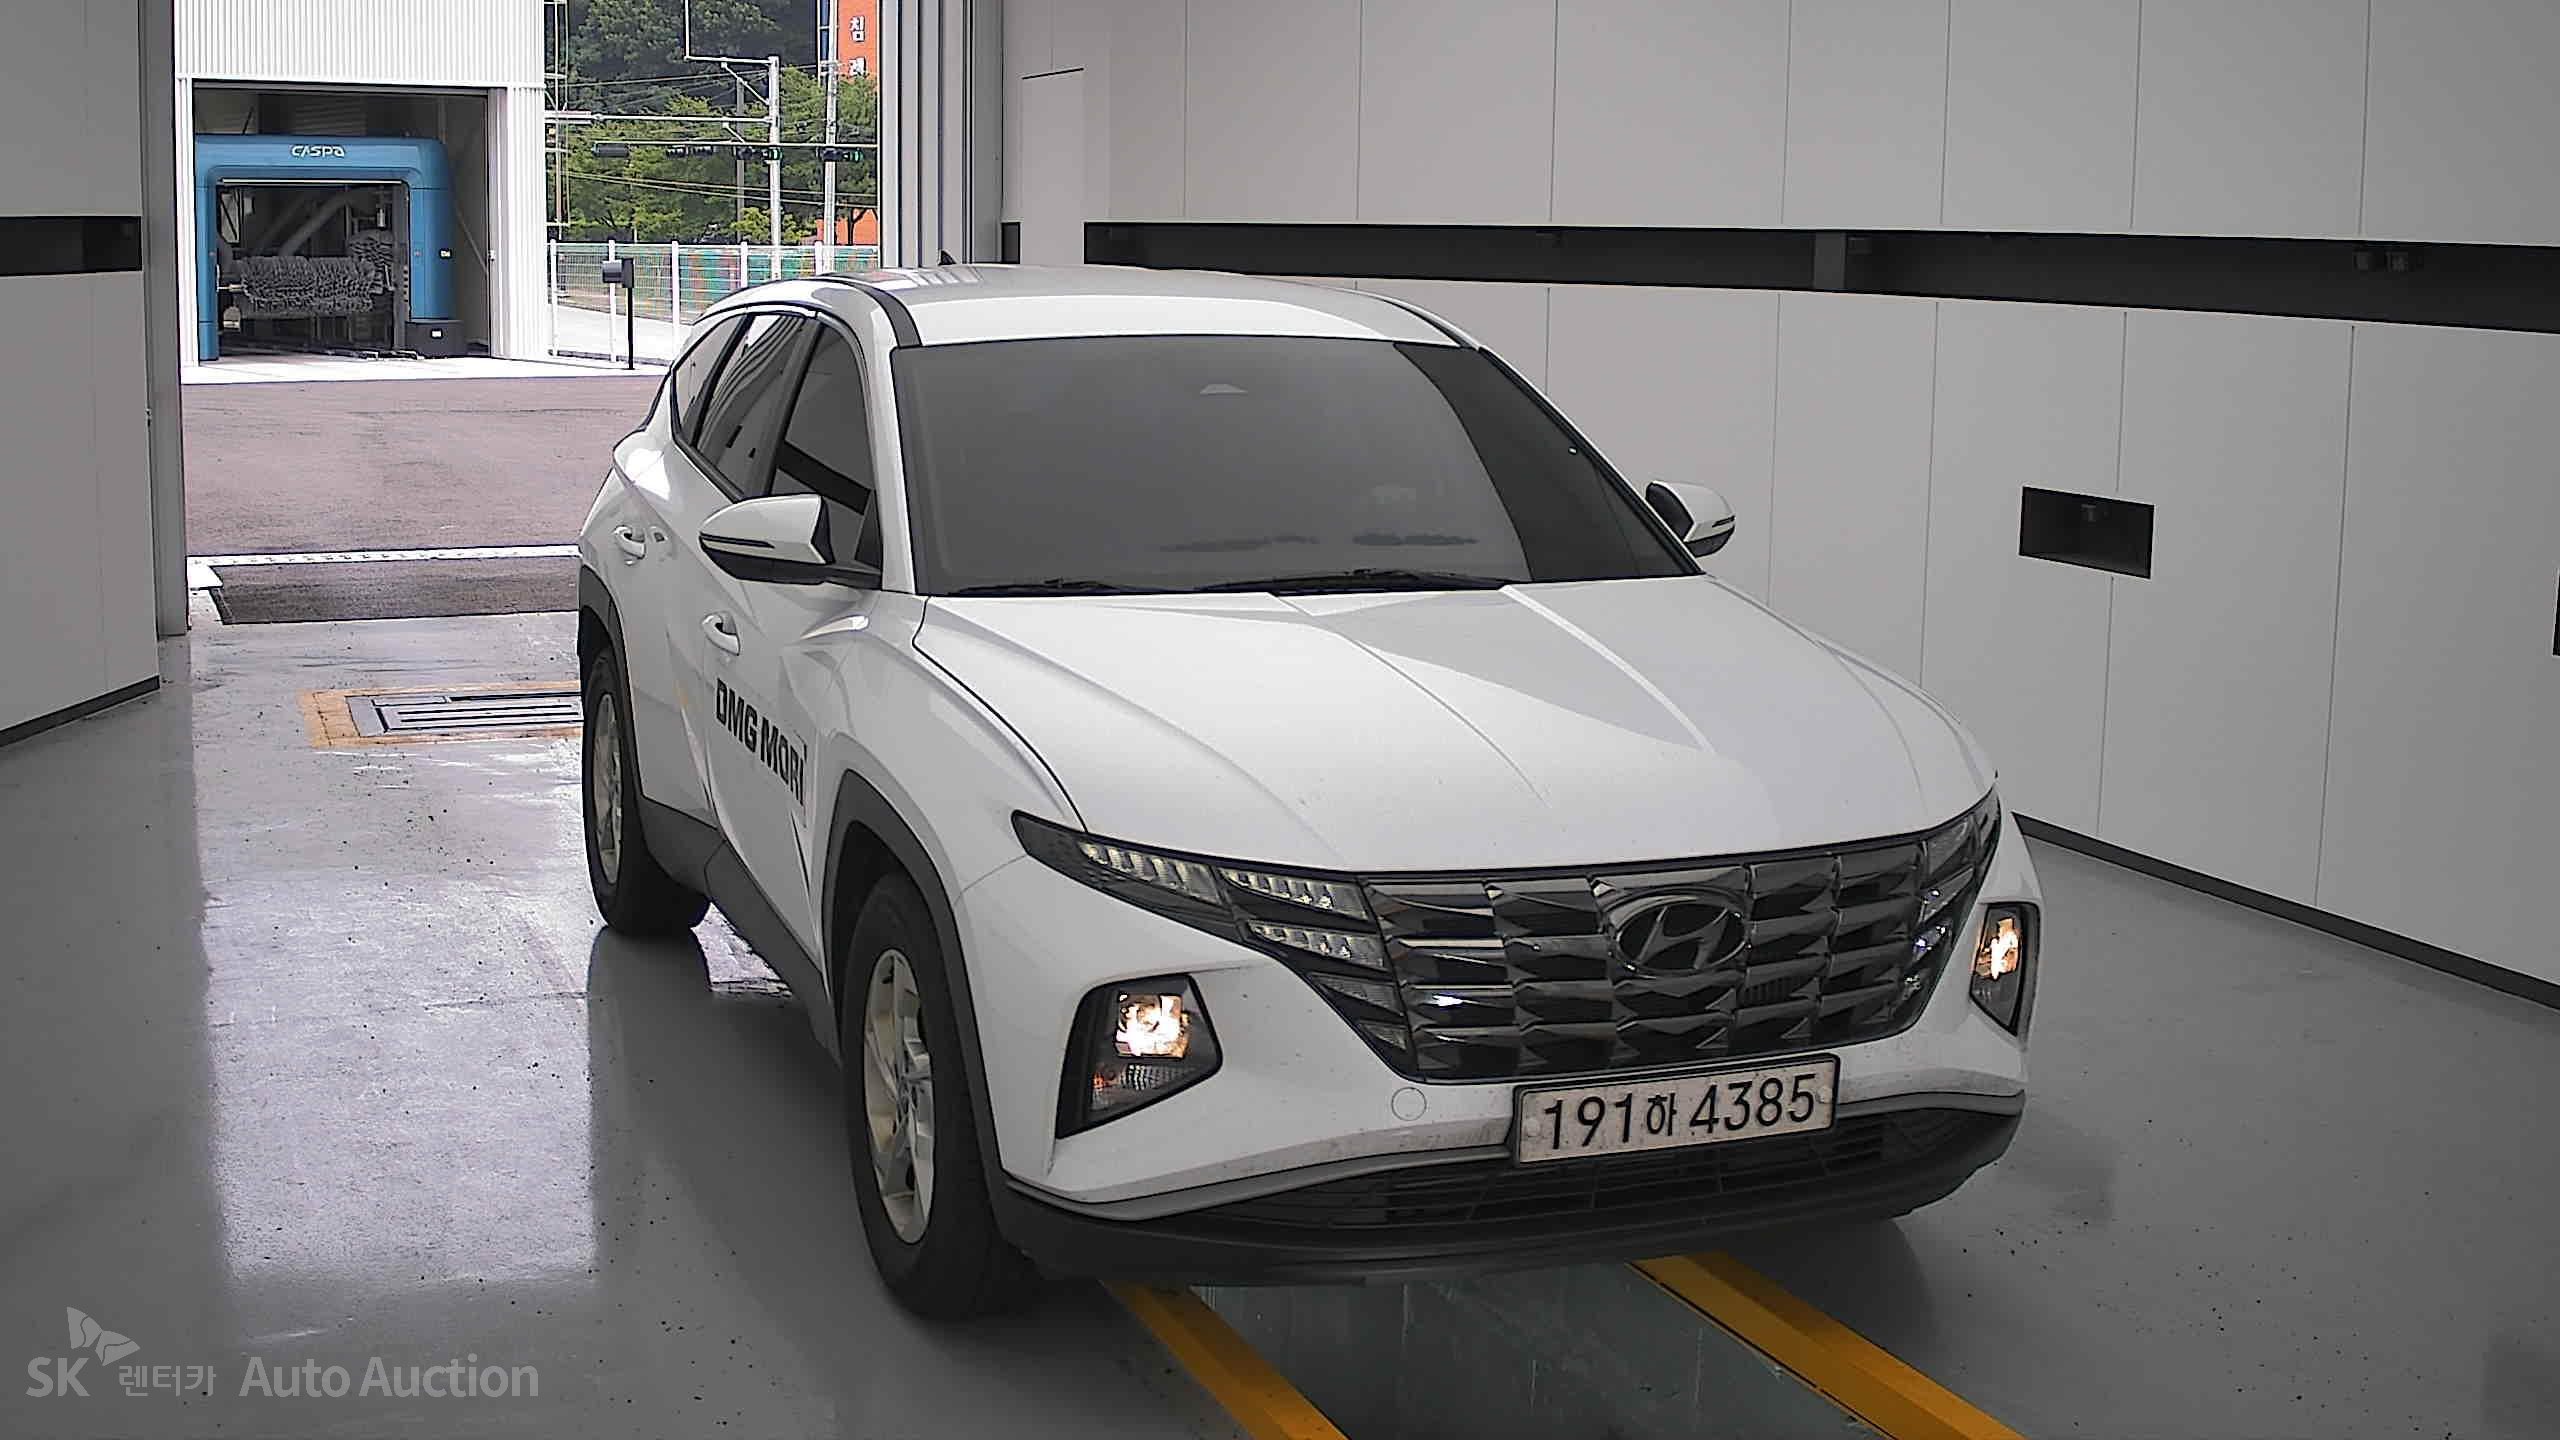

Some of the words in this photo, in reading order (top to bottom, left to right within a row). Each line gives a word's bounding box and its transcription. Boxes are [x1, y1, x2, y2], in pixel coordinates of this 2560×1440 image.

[716, 677, 758, 753] DMG
[760, 716, 804, 806] MORI
[1689, 1073, 1817, 1134] 4385
